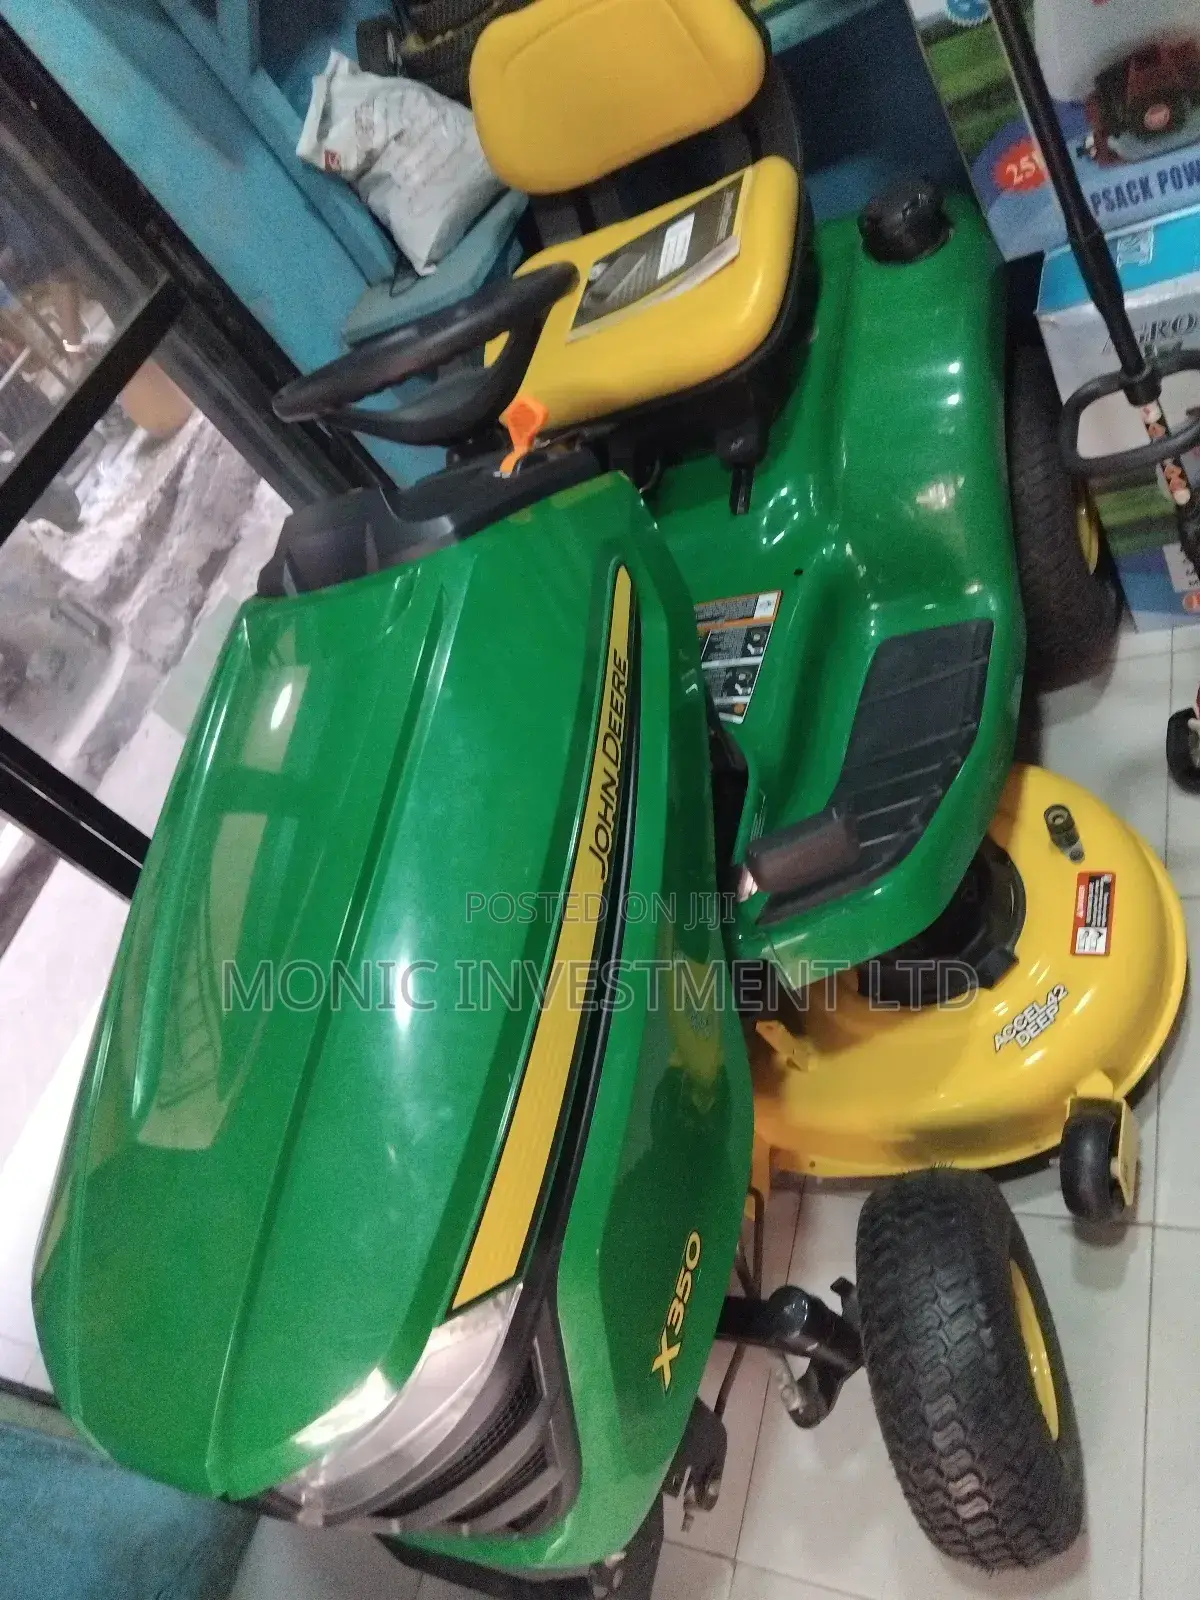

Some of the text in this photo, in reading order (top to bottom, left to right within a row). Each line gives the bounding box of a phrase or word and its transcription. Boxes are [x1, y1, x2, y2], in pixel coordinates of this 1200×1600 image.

[1090, 175, 1154, 215] PSACK
[589, 648, 628, 881] JOHN DEERE
[993, 1001, 1048, 1052] ACCEL
[1014, 1003, 1059, 1049] DEEP
[651, 1230, 701, 1392] X350
